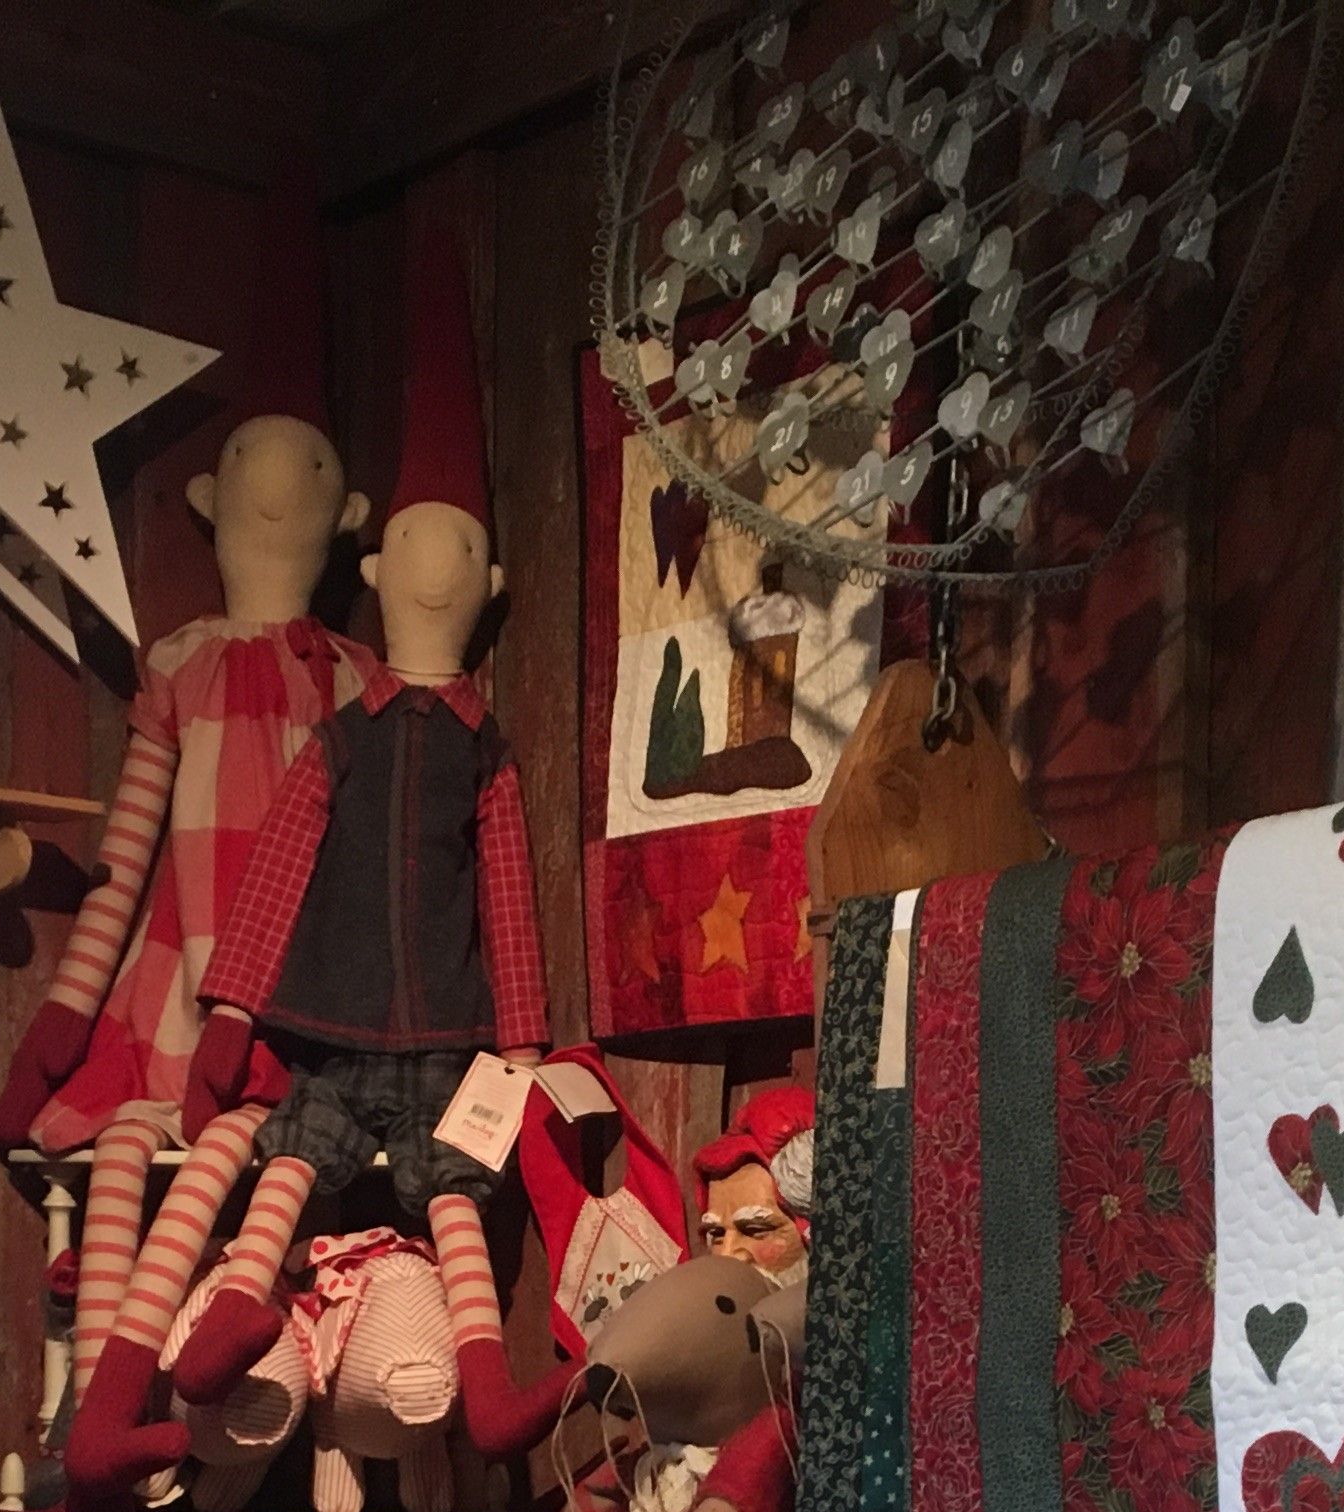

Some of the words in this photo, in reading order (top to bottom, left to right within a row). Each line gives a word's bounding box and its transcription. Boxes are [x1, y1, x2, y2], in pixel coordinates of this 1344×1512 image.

[1011, 50, 1024, 77] 6
[653, 281, 668, 309] 2
[822, 287, 845, 316] 14
[989, 288, 1012, 318] 11
[1059, 308, 1079, 343] 11
[721, 354, 733, 380] 8
[885, 361, 898, 391] 9
[770, 420, 796, 452] 21
[901, 457, 917, 485] 5
[850, 469, 870, 504] 21
